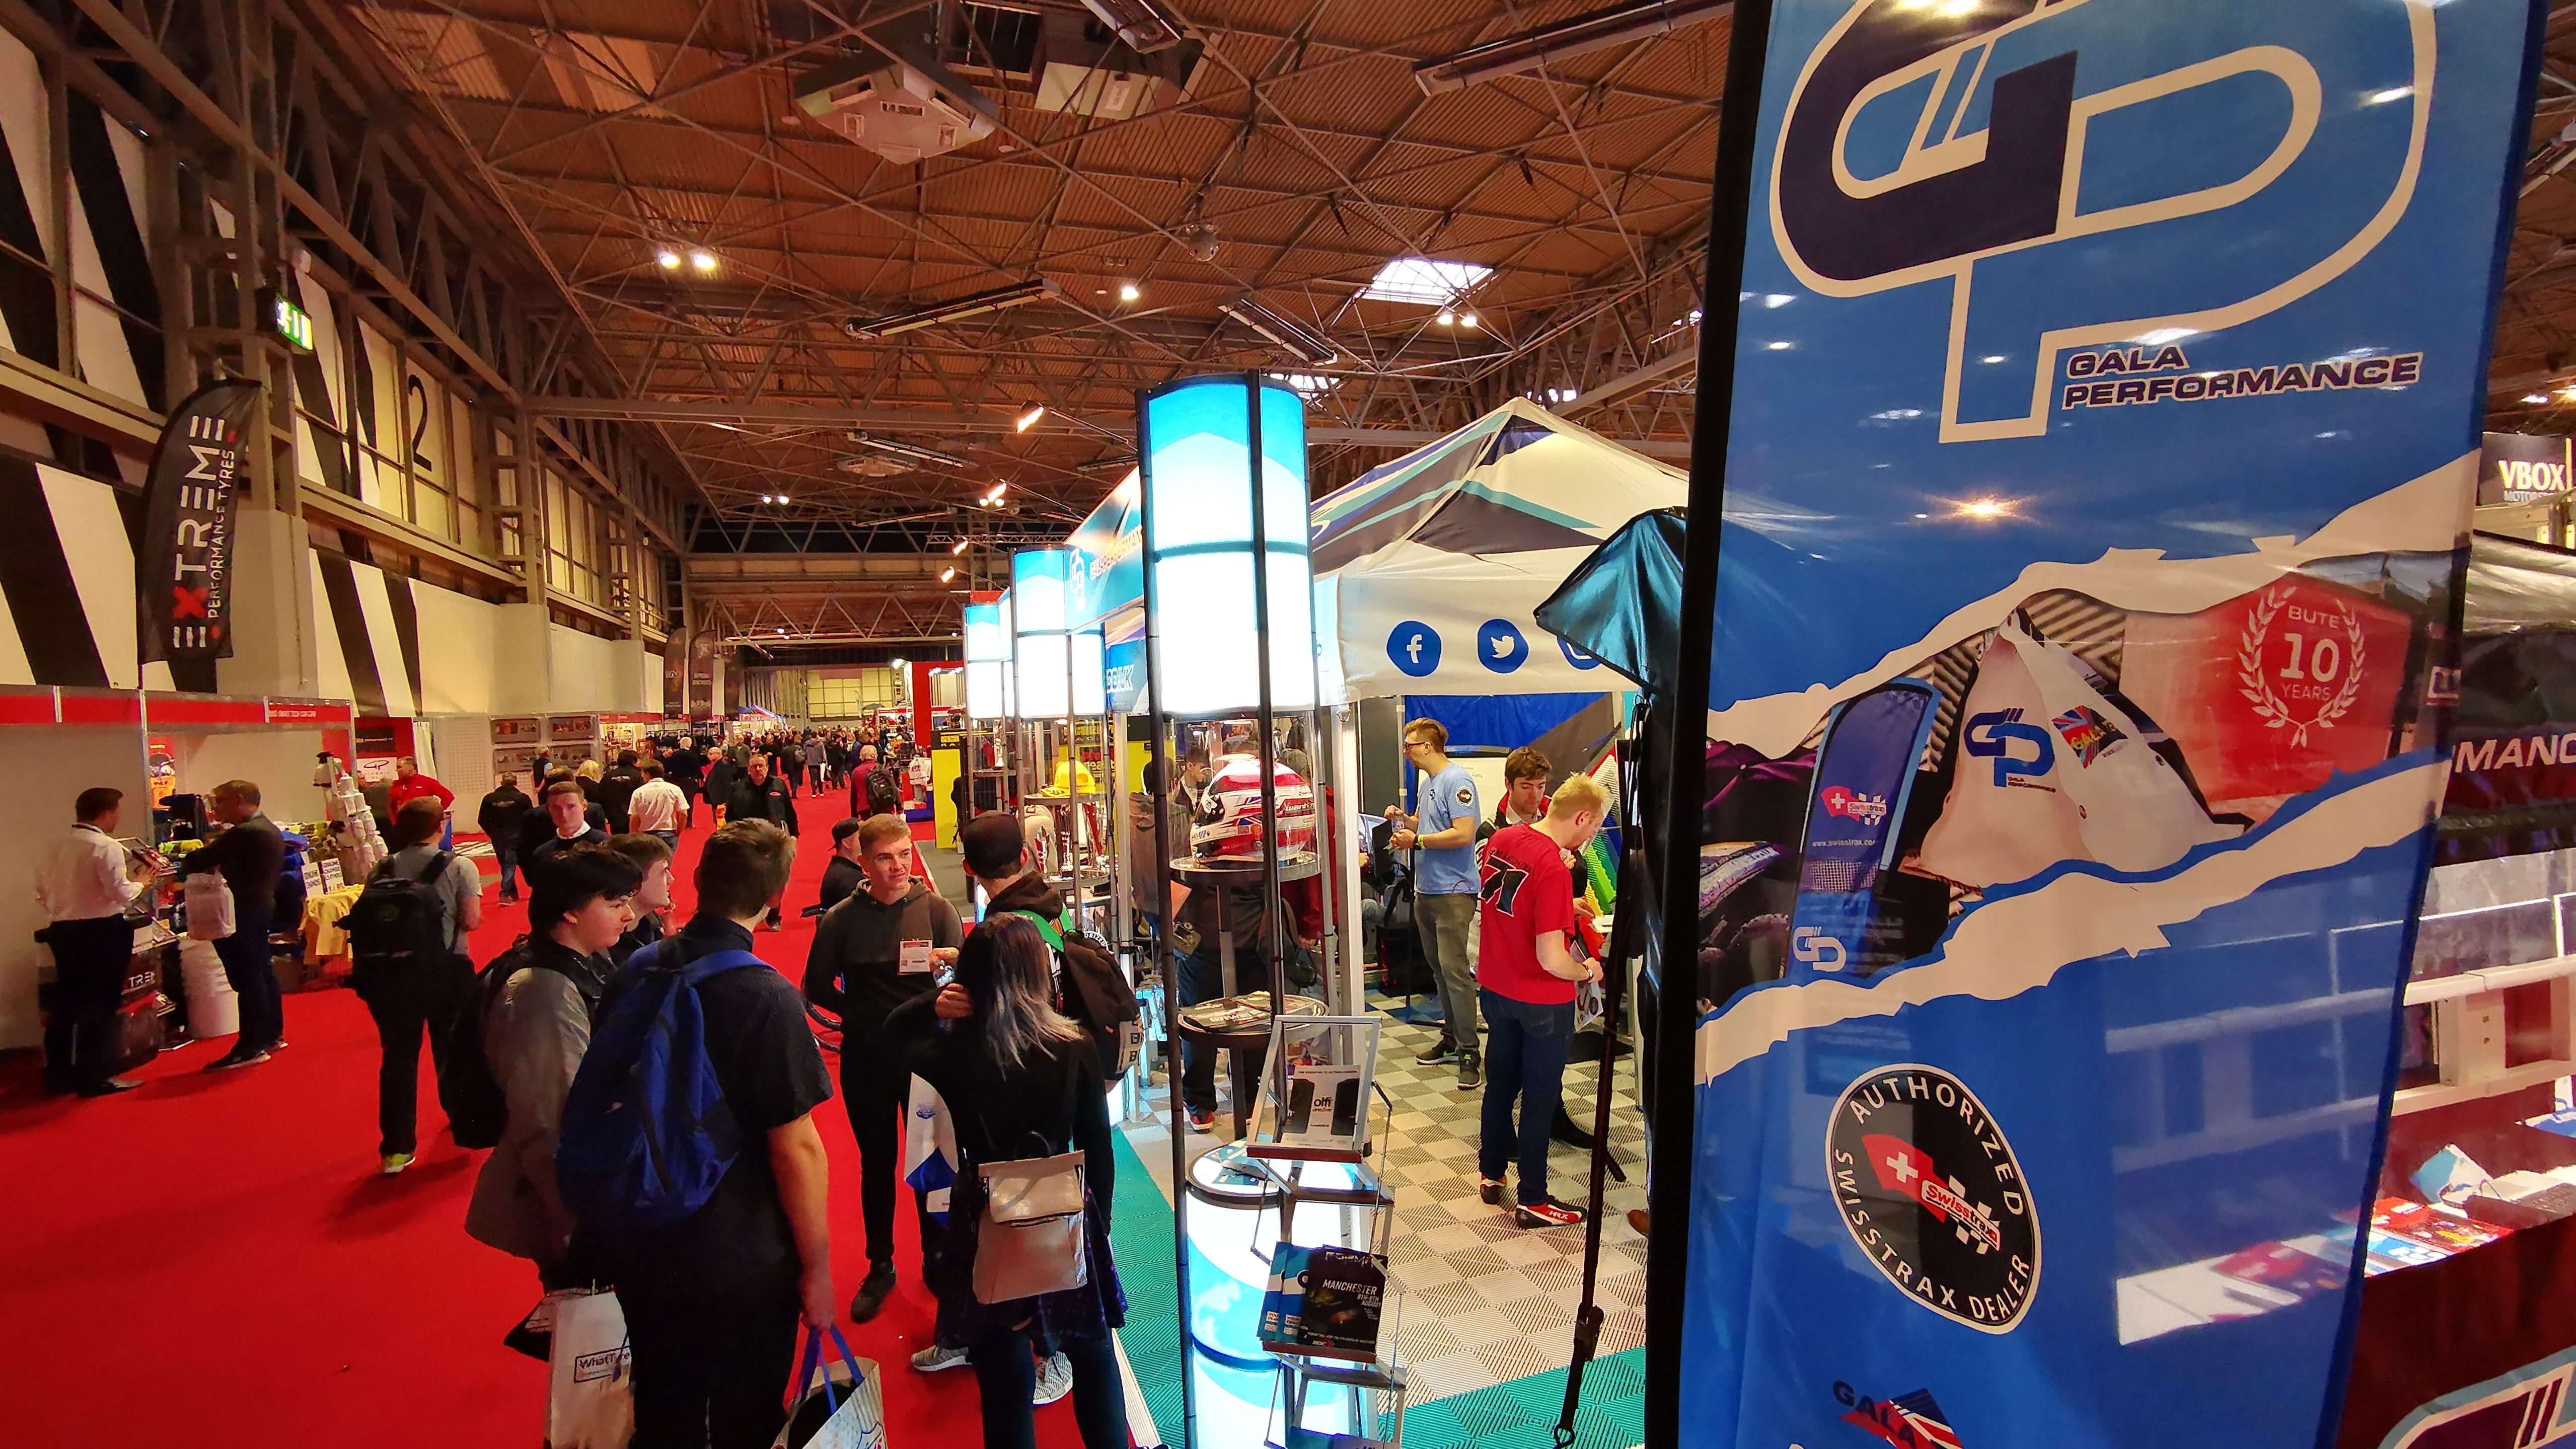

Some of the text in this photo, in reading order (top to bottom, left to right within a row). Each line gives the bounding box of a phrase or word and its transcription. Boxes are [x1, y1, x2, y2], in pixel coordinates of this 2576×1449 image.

[2063, 353, 2422, 409] PERFORMANCE
[2068, 346, 2188, 378] GALA
[409, 373, 432, 472] 2
[2498, 460, 2565, 491] VBOX
[207, 448, 235, 619] PERFORMANCE TYRES
[2289, 605, 2339, 629] BUTE
[2280, 633, 2339, 682] 10
[2281, 684, 2331, 701] YEARS
[2451, 732, 2576, 773] MANC
[1084, 933, 1106, 947] ORIZED
[1849, 1077, 2024, 1215] AUTHORIZED
[1835, 1149, 2030, 1322] SWISSTRAX DEALER
[1322, 1279, 1377, 1295] MANCHESTER
